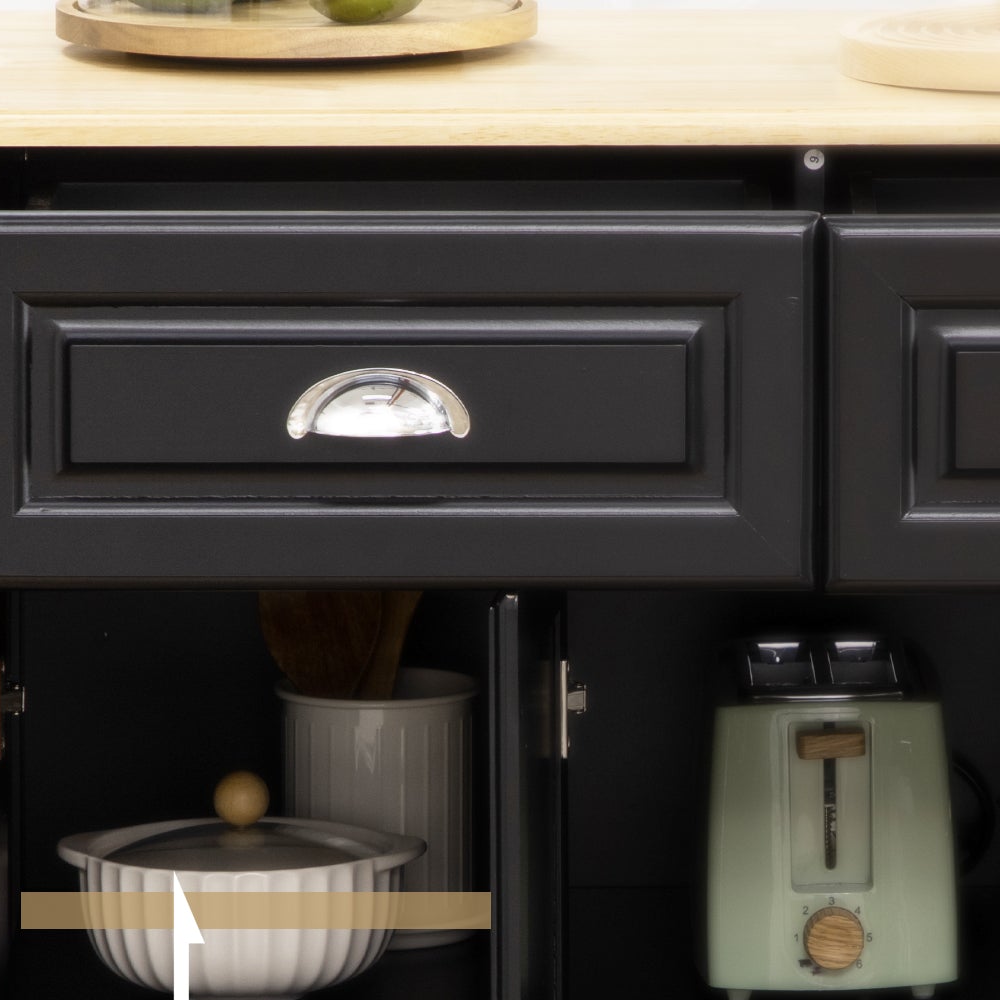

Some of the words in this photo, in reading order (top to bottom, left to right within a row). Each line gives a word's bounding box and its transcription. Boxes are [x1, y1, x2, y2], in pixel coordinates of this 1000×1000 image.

[828, 897, 835, 905] 3
[803, 906, 809, 915] 2
[854, 906, 861, 915] 4
[866, 933, 873, 942] 5
